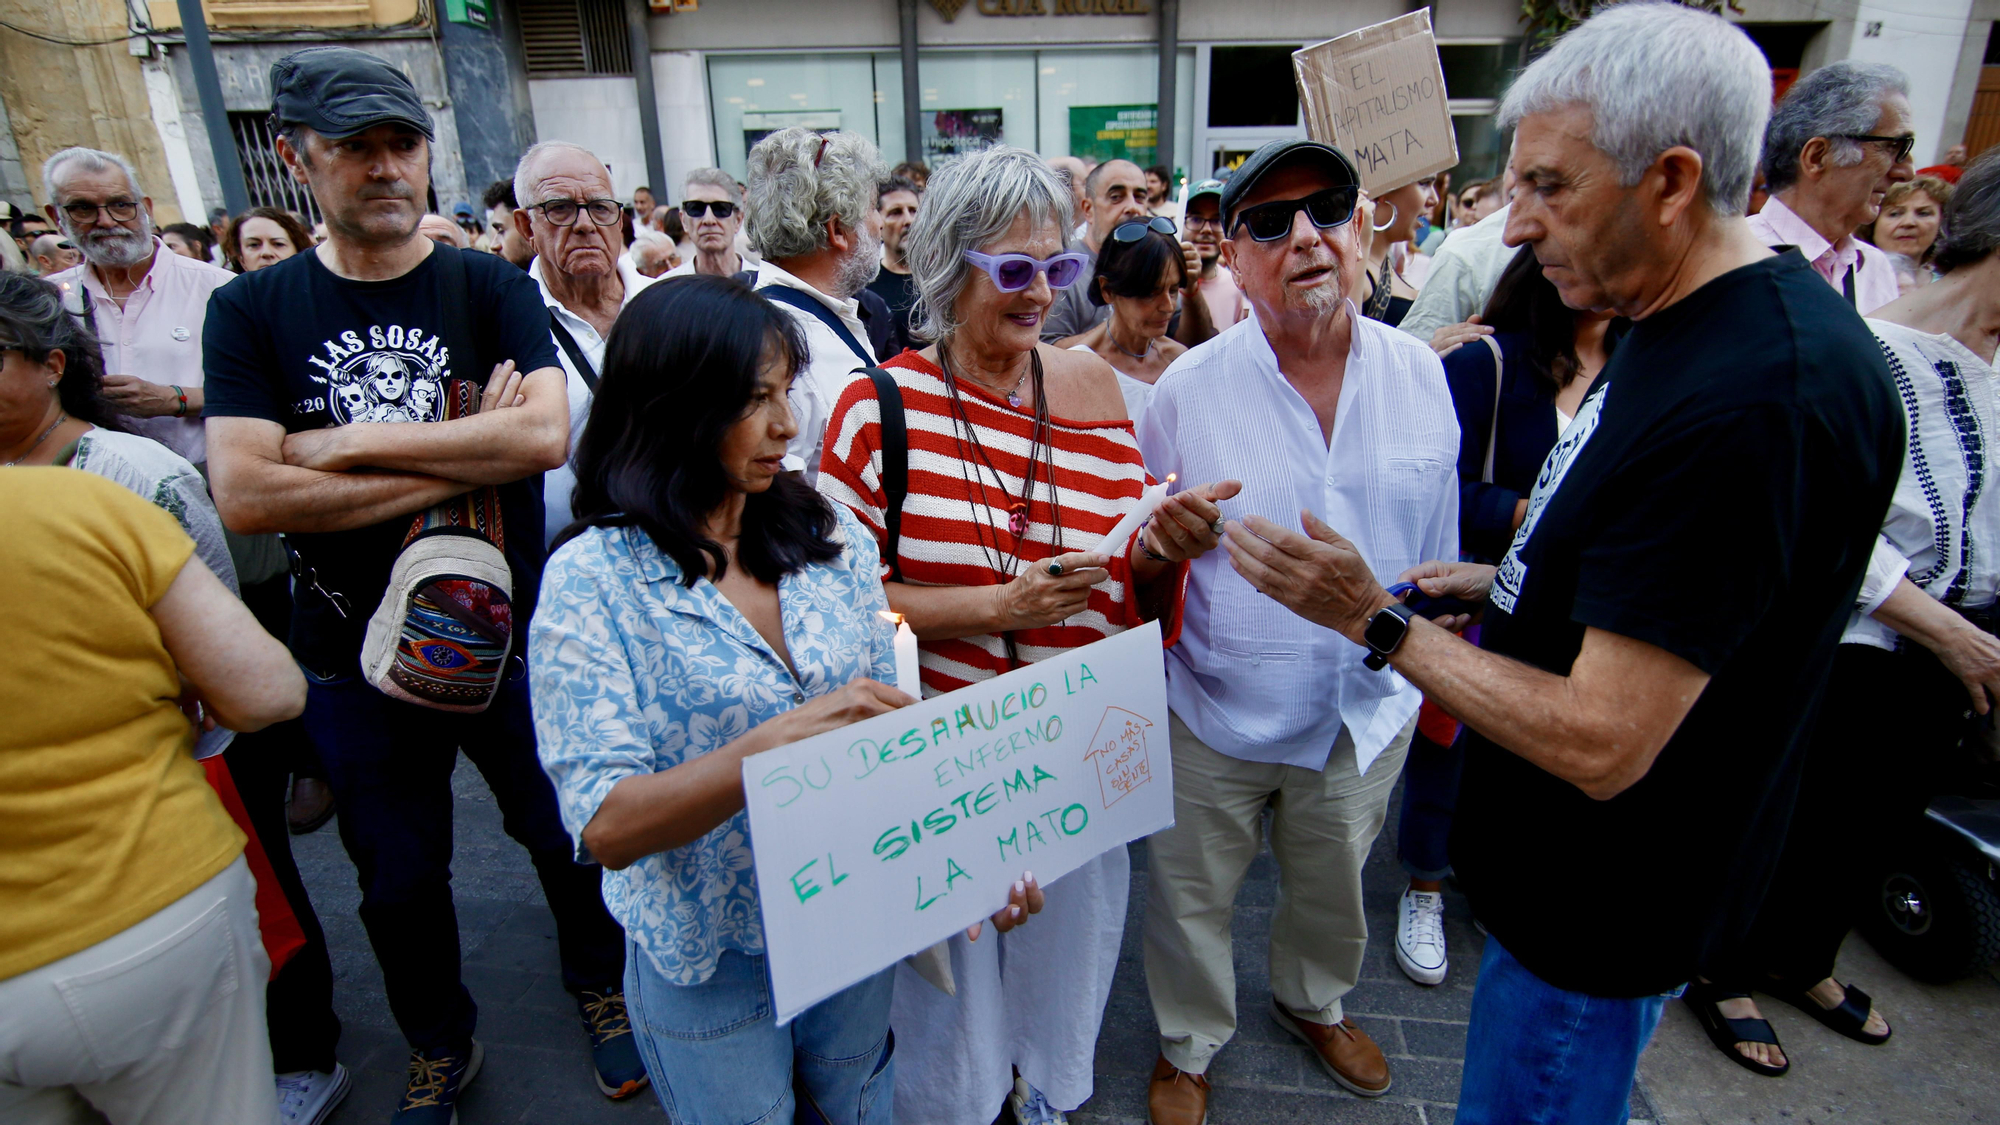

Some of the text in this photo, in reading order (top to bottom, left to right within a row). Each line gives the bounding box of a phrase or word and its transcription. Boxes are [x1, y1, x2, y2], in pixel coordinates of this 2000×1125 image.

[1350, 62, 1385, 91] EL
[1322, 77, 1434, 143] CAPITALISMO
[1354, 129, 1424, 177] MATA
[308, 325, 450, 371] LAS SOSAS
[761, 756, 833, 808] SU
[1064, 663, 1099, 696] LA
[933, 714, 1063, 788] ENFERMO
[1100, 740, 1117, 758] NO
[1106, 740, 1141, 775] CASAS
[1111, 765, 1130, 789] SIN
[788, 764, 1058, 904] EL SISTEMA
[914, 802, 1090, 911] LA MATO
